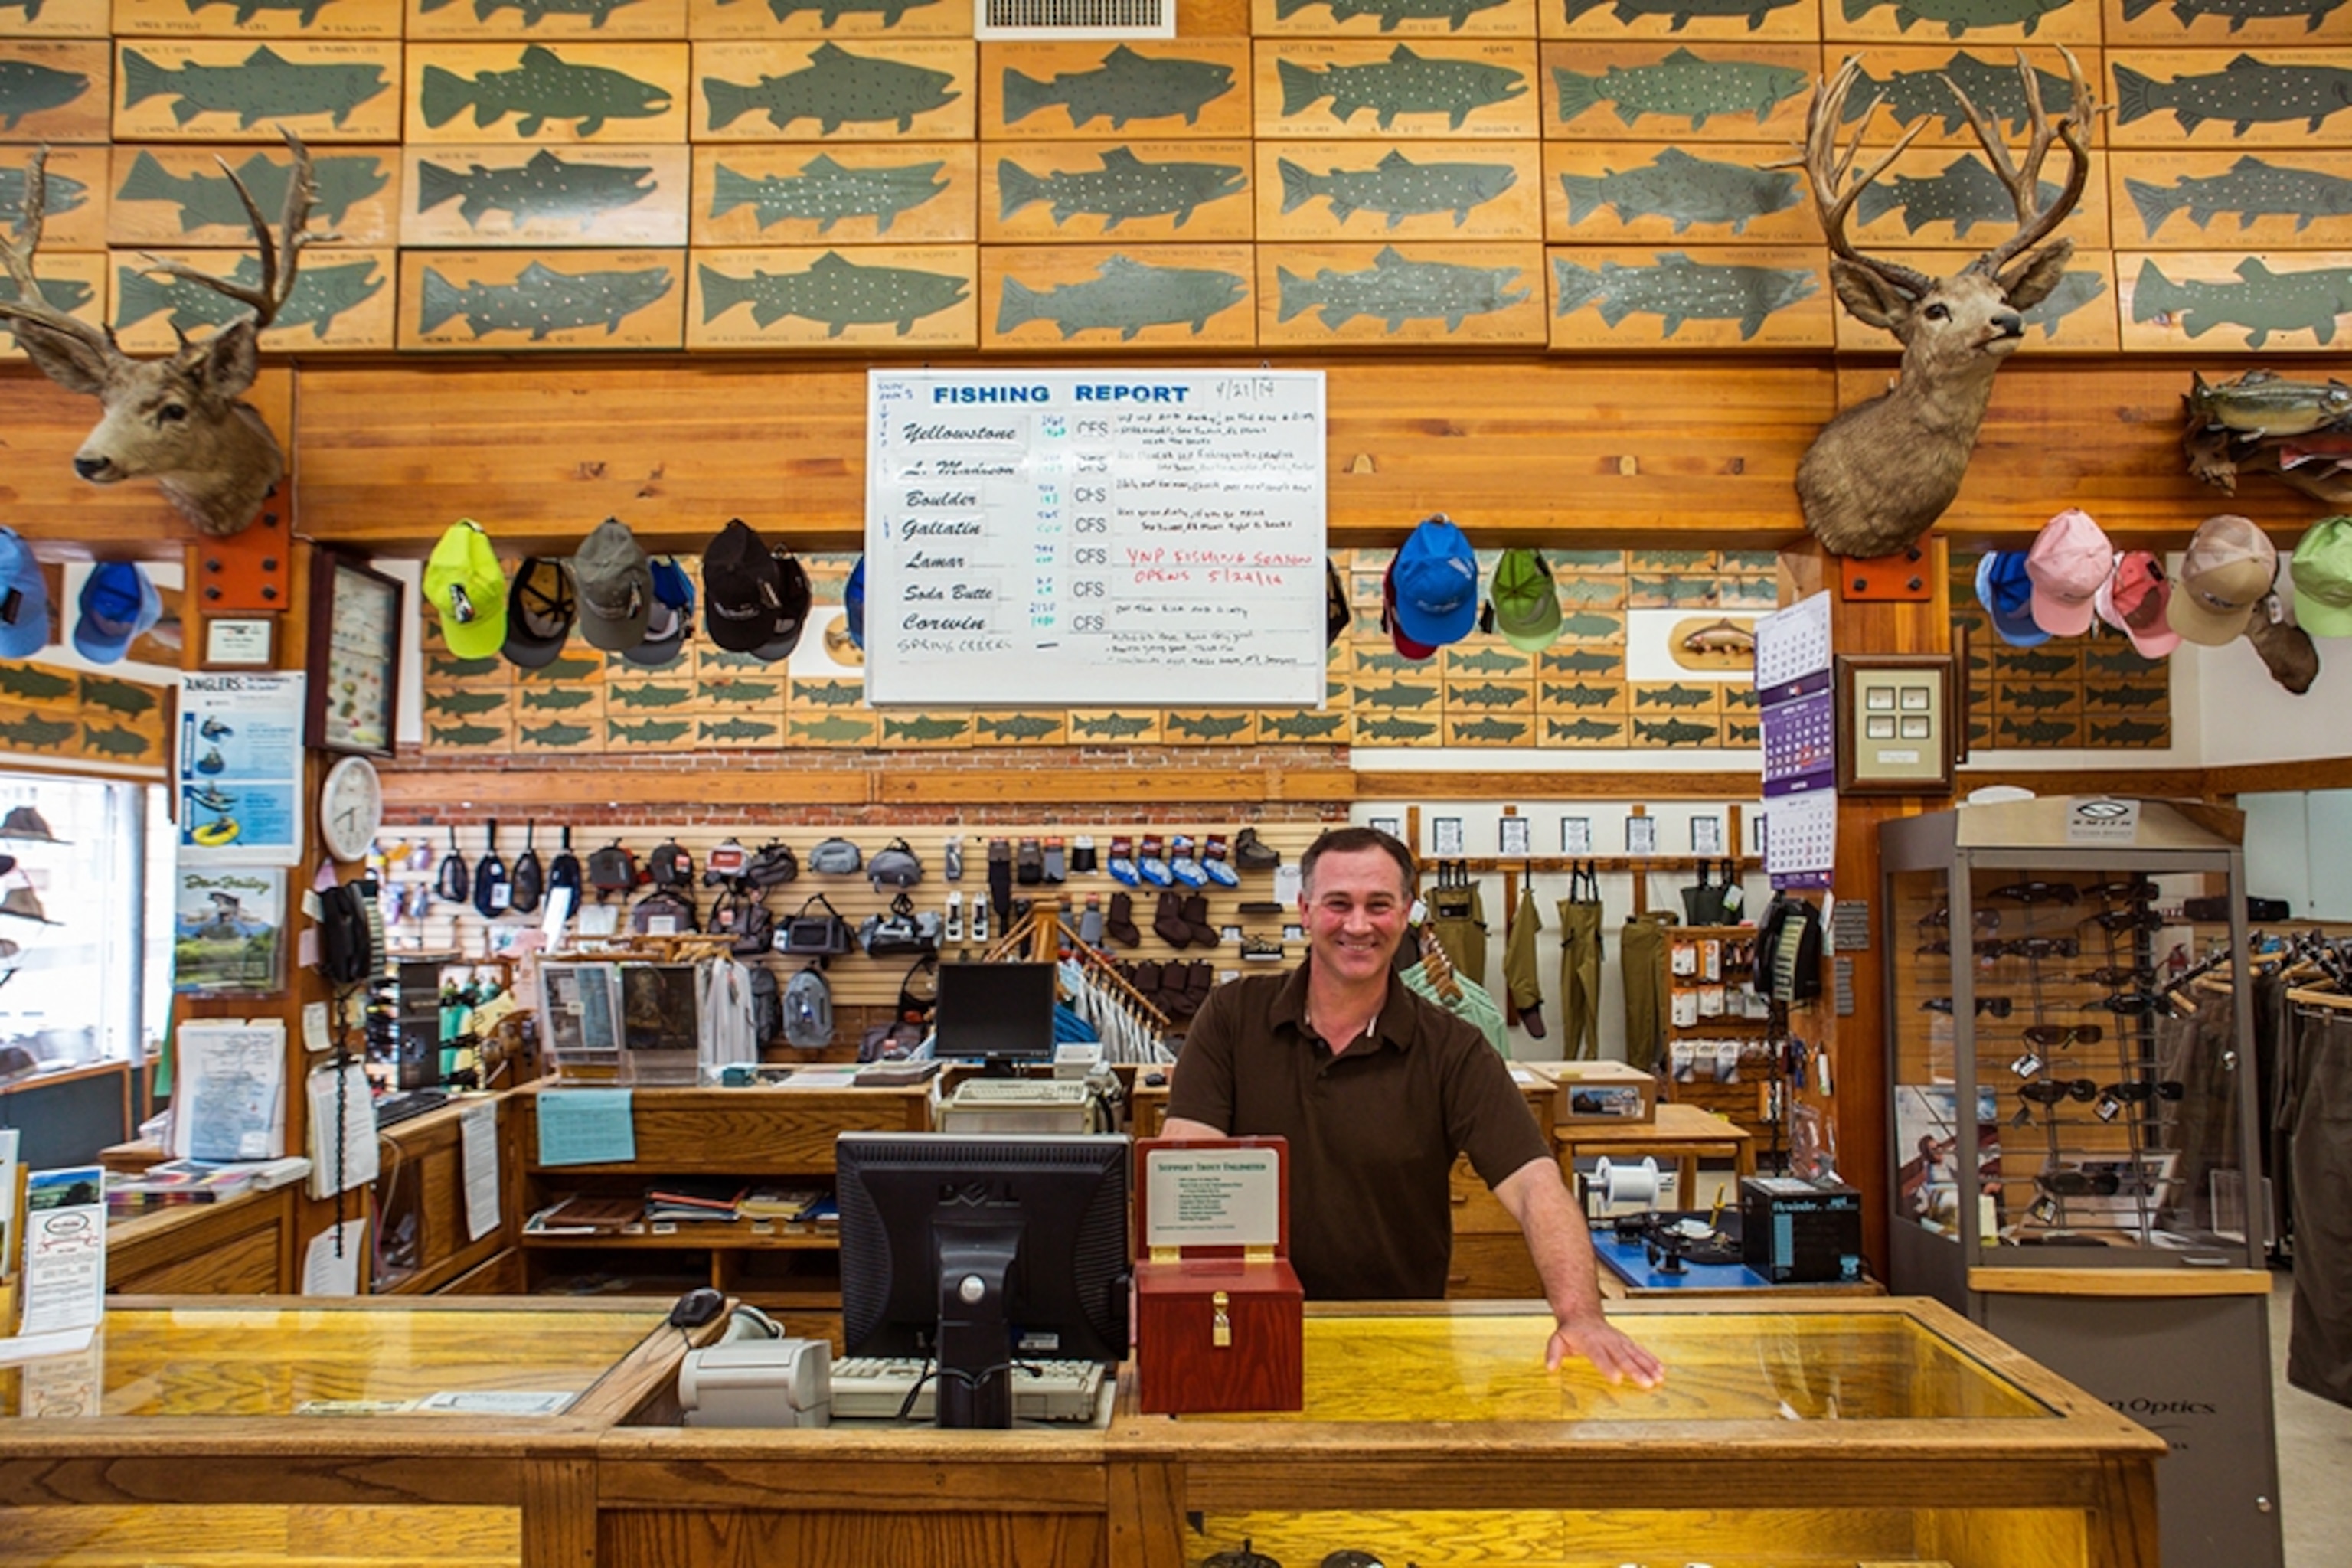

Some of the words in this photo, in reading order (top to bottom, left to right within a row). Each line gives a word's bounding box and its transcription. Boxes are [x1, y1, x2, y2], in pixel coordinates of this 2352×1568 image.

[933, 386, 1050, 403] FISHING
[1075, 385, 1190, 403] REPORT
[903, 423, 1017, 444] Yellowstone
[1076, 420, 1109, 437] CFS
[906, 489, 978, 508] Boulder
[1075, 486, 1106, 504] CFS
[902, 519, 982, 541] Gallatin
[1075, 517, 1107, 534] CFS
[905, 551, 965, 569] Lamar
[1075, 548, 1107, 566] CFS
[903, 585, 944, 602] Soda
[952, 584, 994, 601] Butte
[1073, 580, 1105, 598] CFS
[902, 613, 985, 631] Corwin
[1073, 614, 1105, 632] CFS
[938, 1183, 1021, 1207] DELL
[2129, 1396, 2216, 1416] Optics
